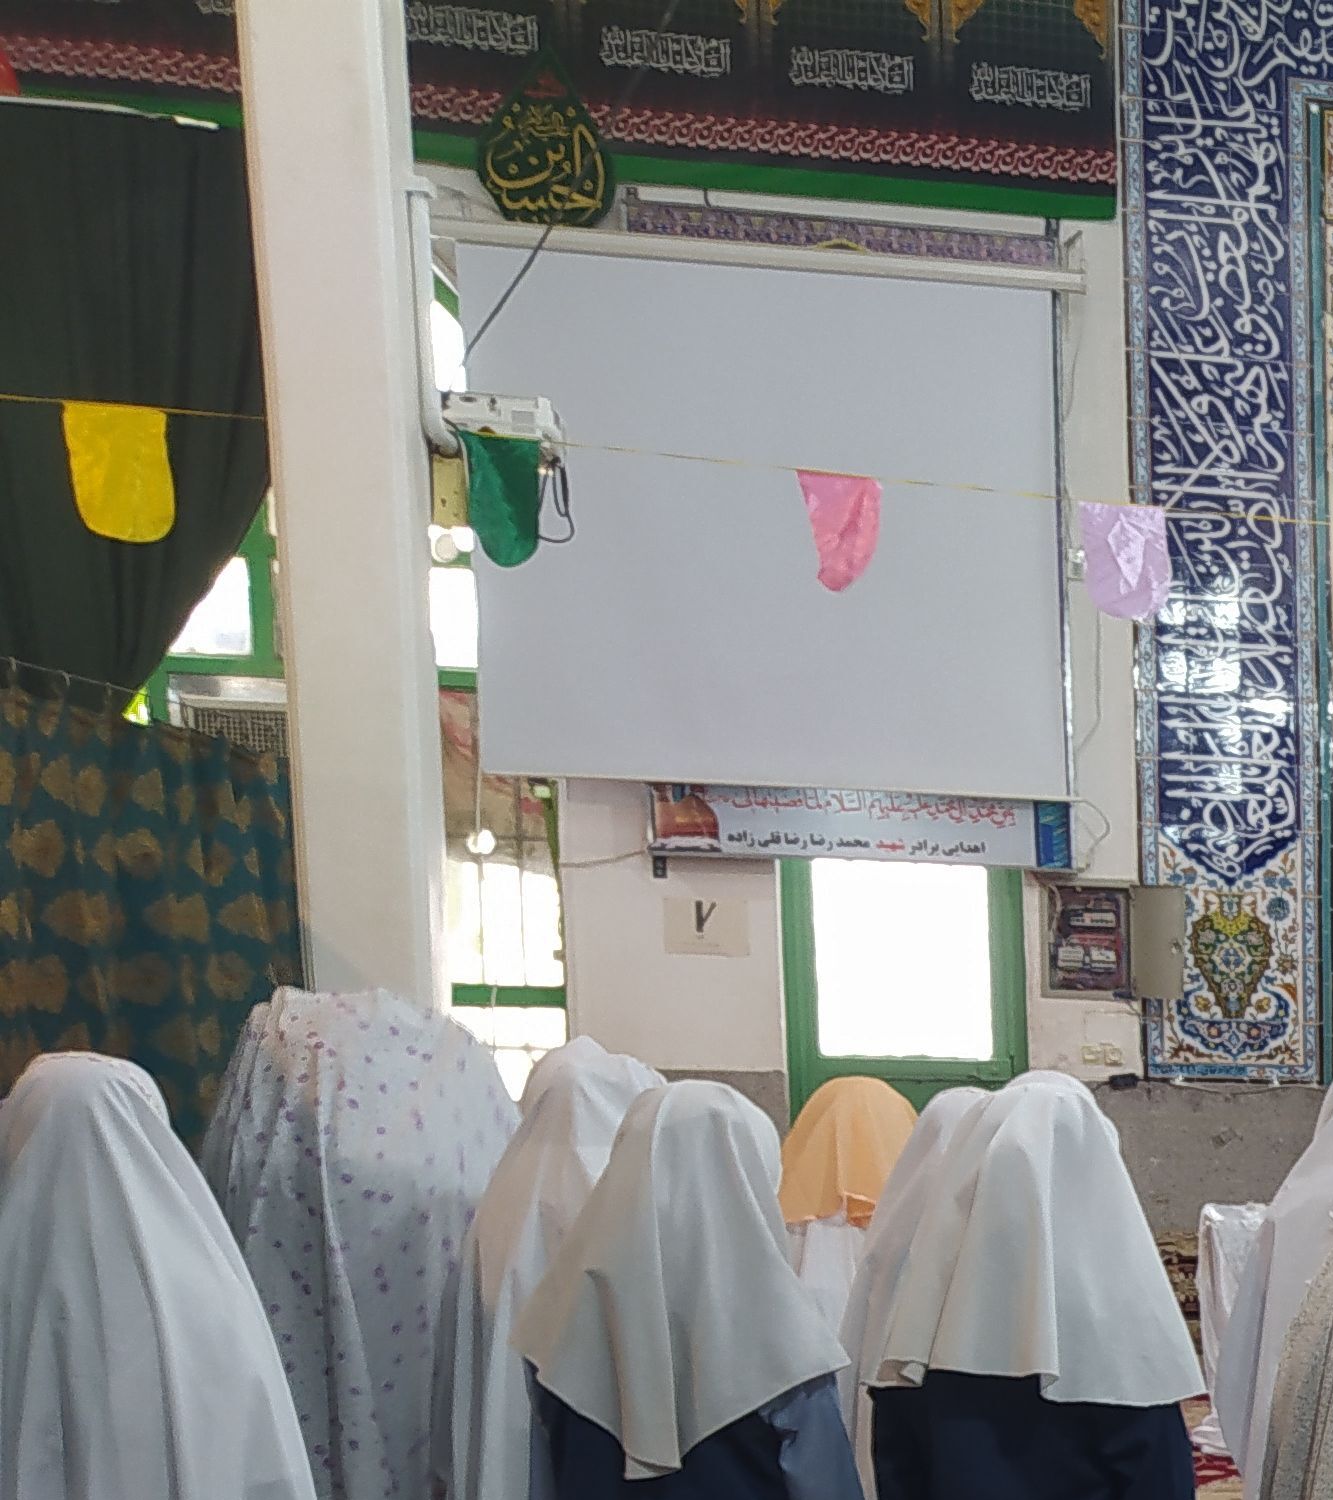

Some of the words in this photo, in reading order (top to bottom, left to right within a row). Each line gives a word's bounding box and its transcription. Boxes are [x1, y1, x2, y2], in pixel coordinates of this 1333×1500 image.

[728, 830, 755, 848] زاده
[758, 830, 782, 848] قلی
[784, 832, 808, 850] رضا
[809, 833, 834, 851] رضا
[836, 837, 871, 849] محمد
[876, 838, 905, 853] شهید
